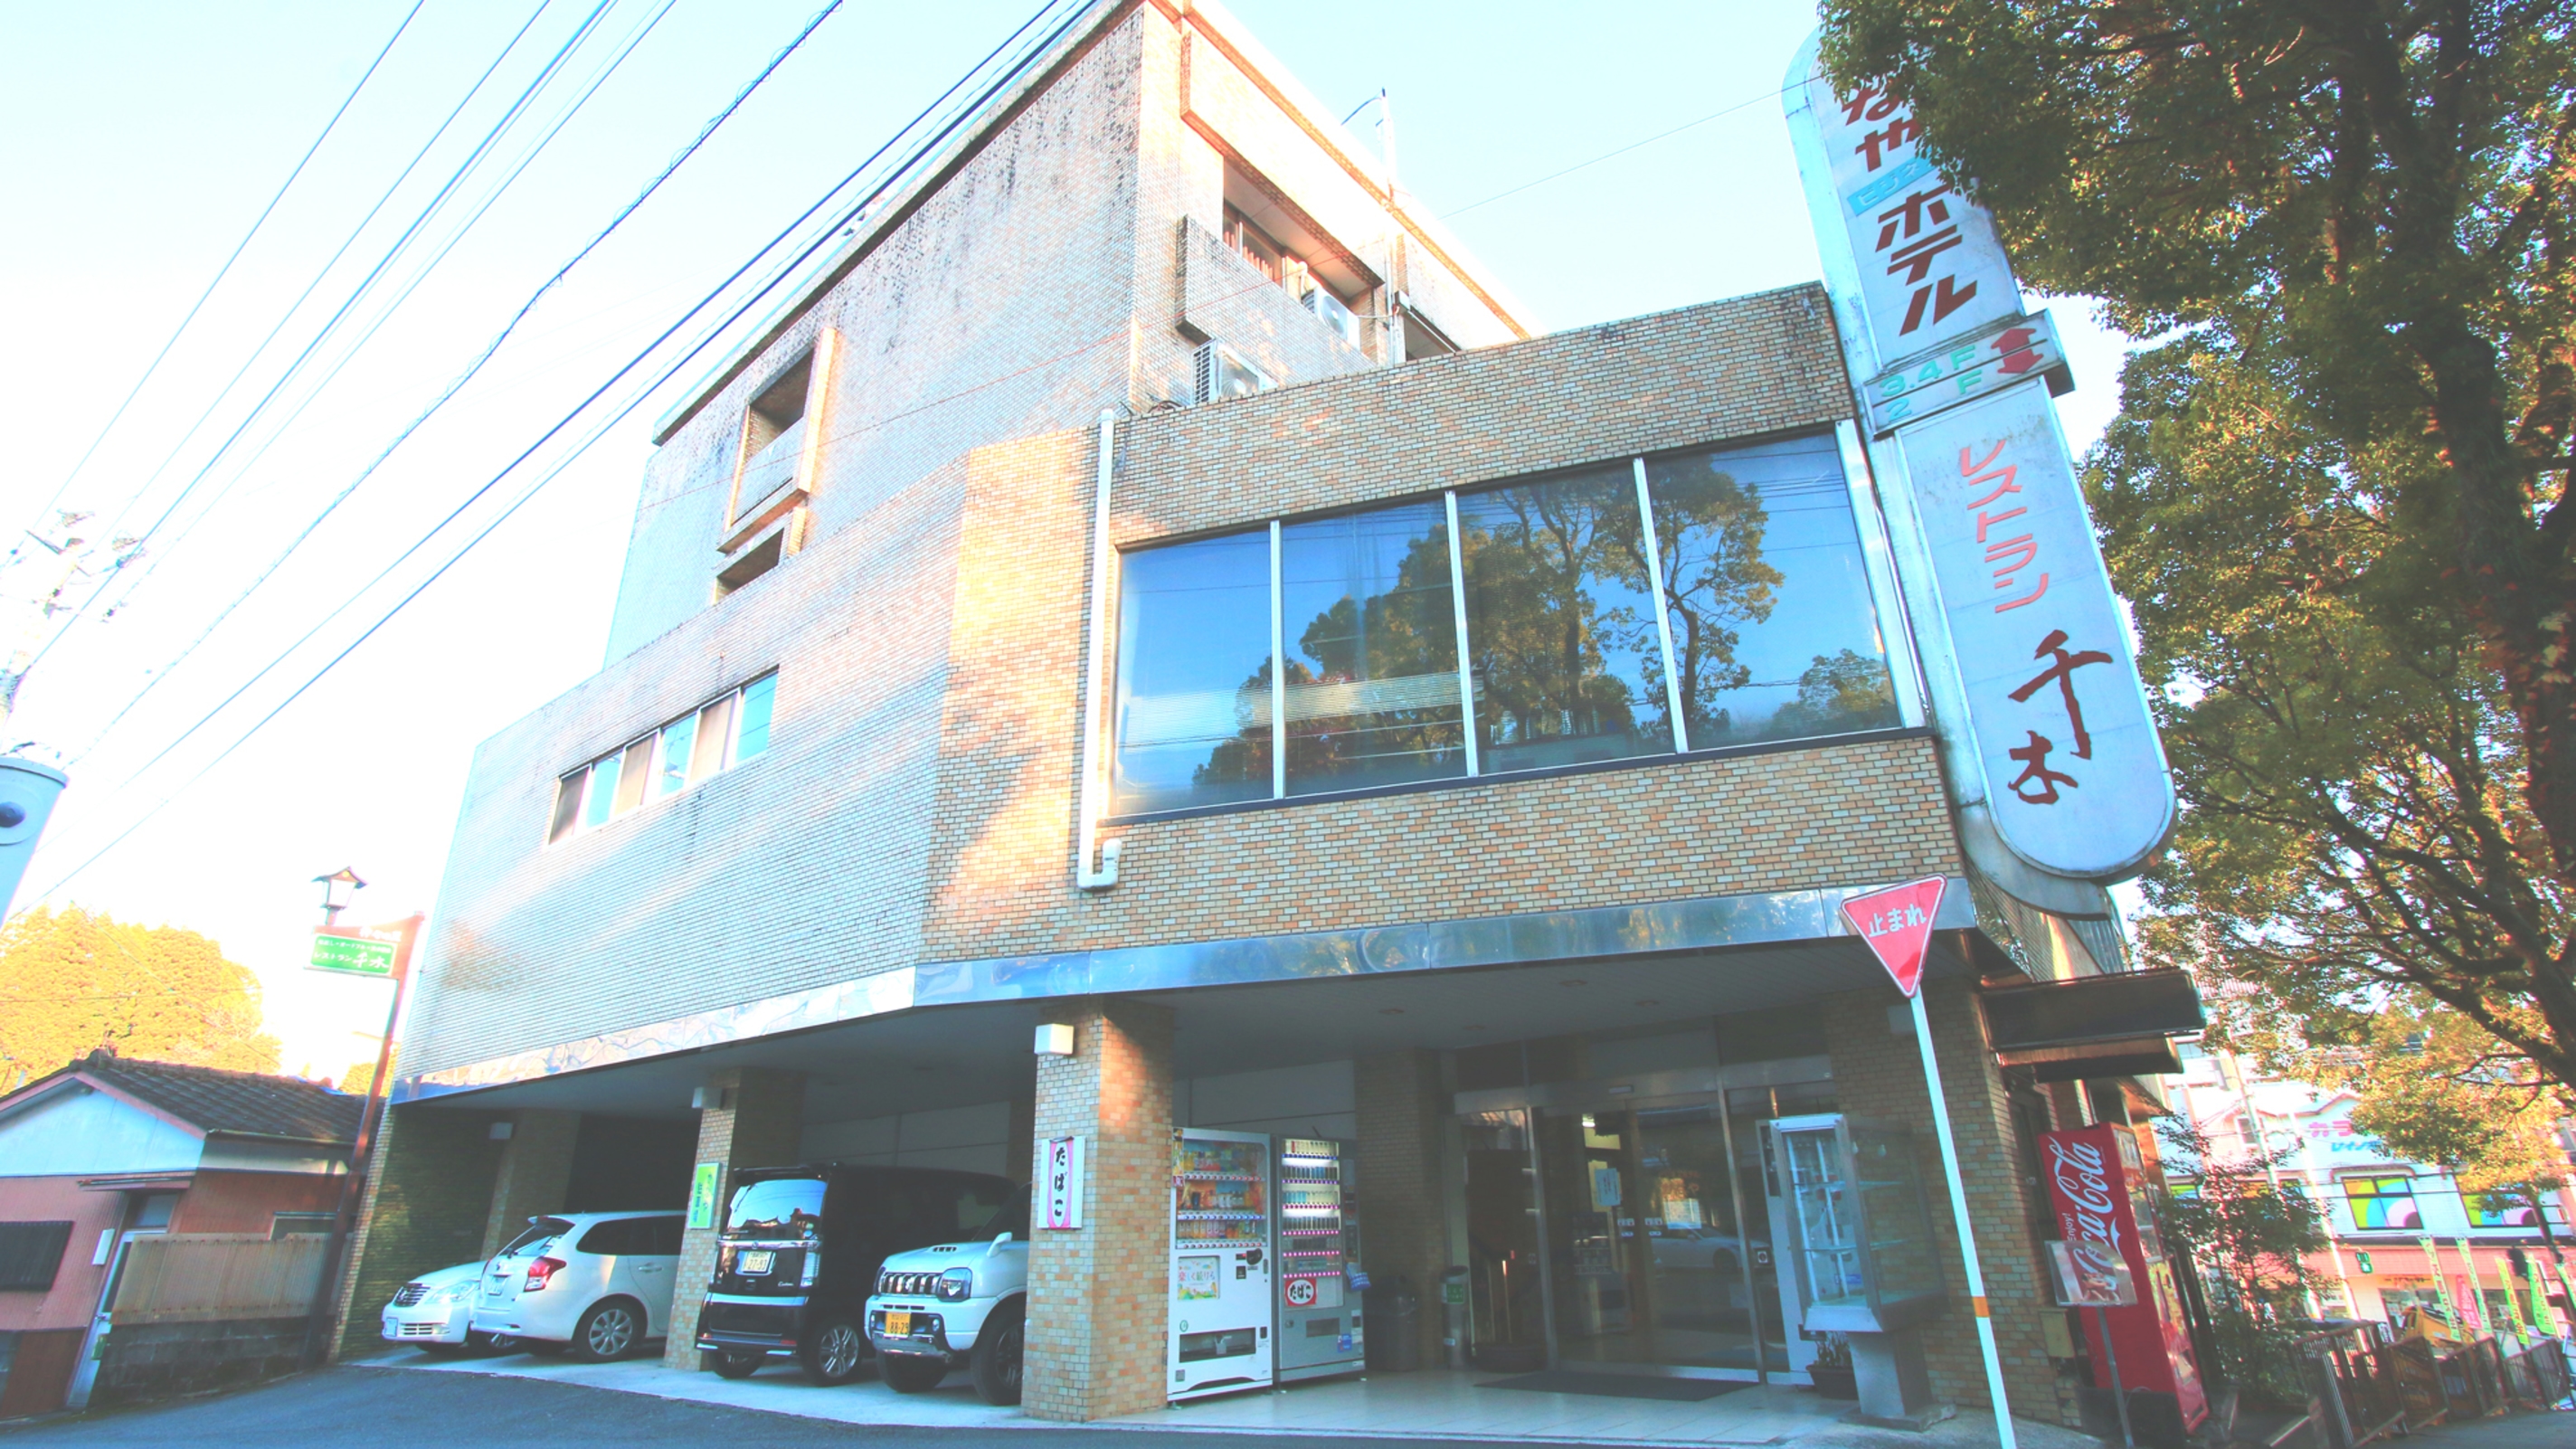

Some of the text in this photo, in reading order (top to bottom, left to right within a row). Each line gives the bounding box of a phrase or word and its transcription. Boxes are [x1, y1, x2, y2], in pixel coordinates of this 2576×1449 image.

[1875, 184, 1977, 336] ホテル
[1887, 369, 1983, 422] 2 F
[1960, 439, 2050, 614] レストラン
[1868, 904, 1927, 937] 止まれ
[2308, 1122, 2353, 1137] カラ
[1054, 1146, 1068, 1217] たばこ
[2061, 1212, 2078, 1242] Enjoy!
[1290, 1283, 1312, 1300] たばこ
